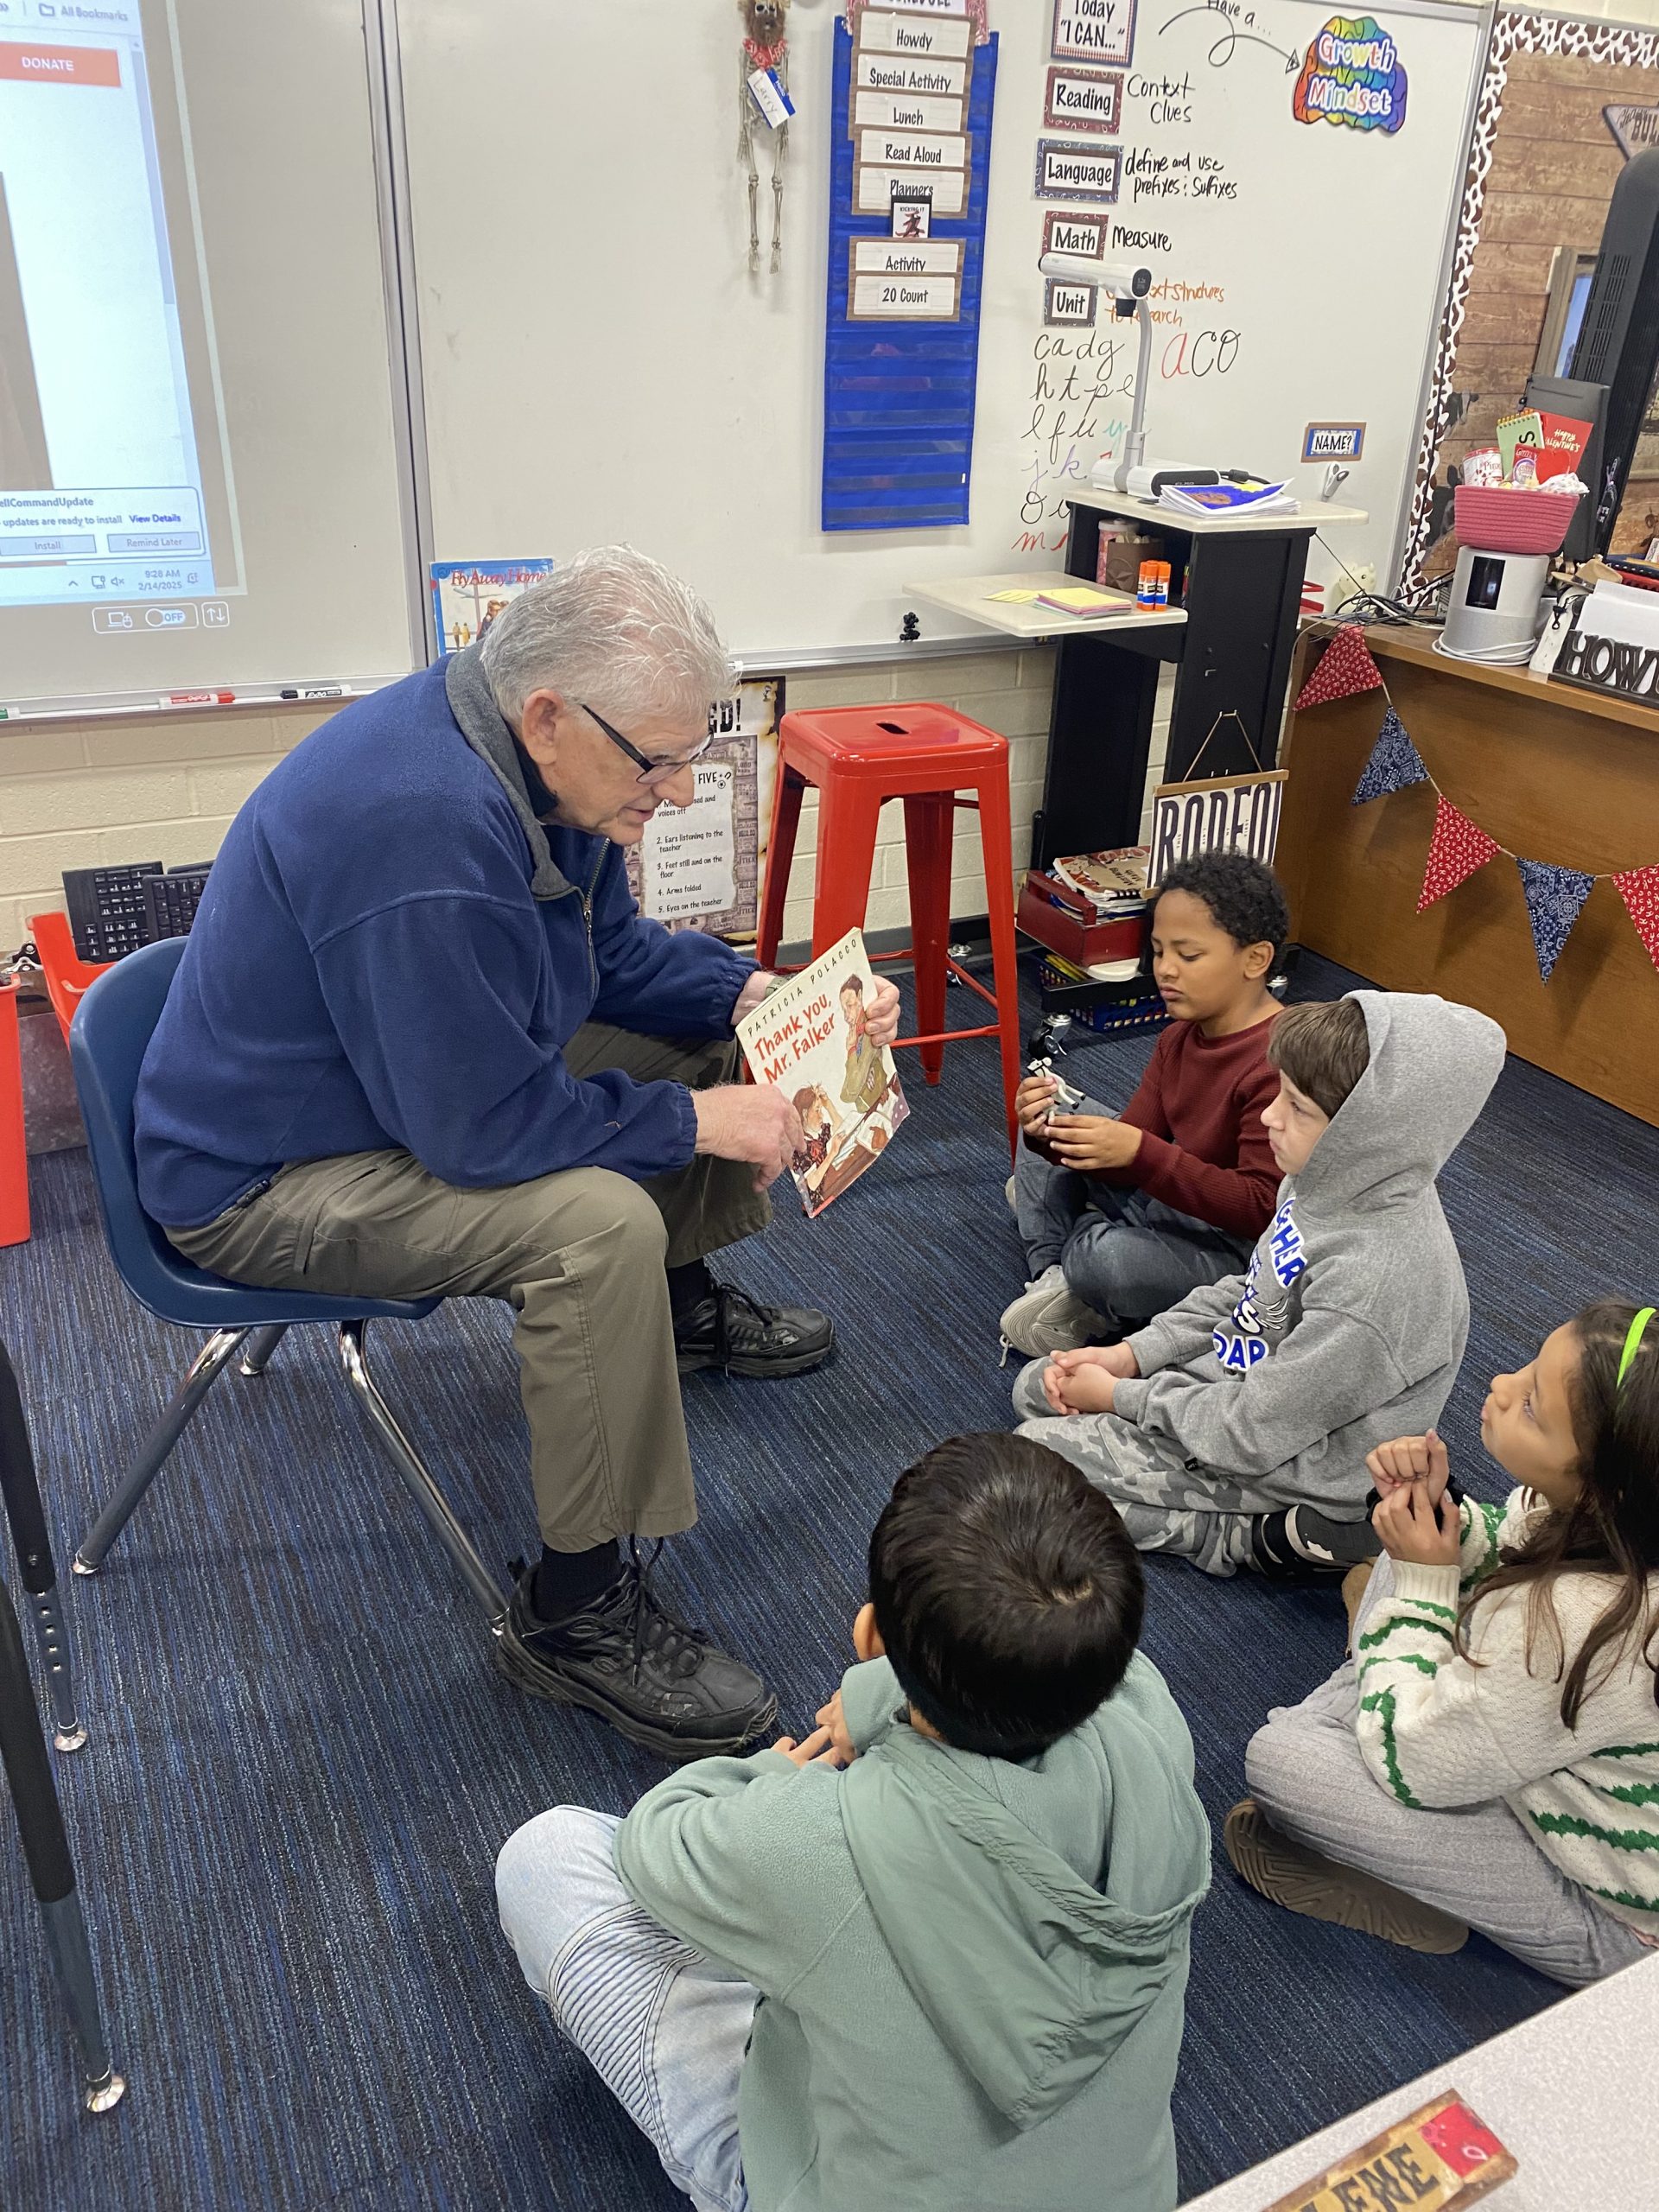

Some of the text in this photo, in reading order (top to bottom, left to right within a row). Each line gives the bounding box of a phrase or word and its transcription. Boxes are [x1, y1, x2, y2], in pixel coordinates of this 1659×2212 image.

[61, 5, 128, 22] All Bookmarks
[1075, 0, 1115, 22] Today
[897, 29, 932, 51] Howdy
[1319, 33, 1395, 73] Growth
[22, 56, 74, 71] DONATE
[869, 67, 951, 92] Special Activity
[1056, 84, 1112, 115] Reading
[1308, 77, 1392, 116] Mindset
[893, 107, 924, 125] Lunch
[1150, 99, 1192, 124] Clues
[886, 143, 942, 163] Read Aloud
[1126, 147, 1224, 175] define and use
[1047, 156, 1112, 185] Language
[890, 179, 933, 196] Planners
[1135, 175, 1180, 203] prefixes
[1054, 226, 1096, 251] Math
[886, 256, 926, 271] Activity
[882, 288, 928, 303] 20 Count
[1056, 291, 1085, 314] Unit
[1315, 435, 1352, 451] NAME?
[1554, 429, 1576, 442] Happy
[3, 518, 41, 528] updates
[58, 518, 84, 528] ready
[97, 515, 123, 524] install
[129, 514, 150, 524] View
[152, 513, 181, 523] Details
[127, 537, 182, 548] Remind Later
[145, 569, 163, 578] 9:28
[451, 567, 546, 588] Fly Away Home
[138, 582, 182, 591] 2/14/2025
[164, 612, 183, 622] OFF
[698, 772, 717, 785] FIVE
[704, 794, 716, 803] and
[658, 809, 676, 817] voices
[664, 836, 678, 844] Ears
[679, 833, 704, 842] listening
[659, 844, 681, 854] teacher
[665, 861, 677, 869] Feet
[679, 859, 690, 868] still
[684, 883, 702, 893] folded
[666, 904, 680, 912] Eyes
[702, 899, 722, 907] teacher
[747, 938, 856, 1037] PATRICIA POLACCO
[754, 1016, 803, 1062] Thank
[764, 1013, 836, 1084] Mr. Falker
[1299, 2141, 1440, 2212] ENE
